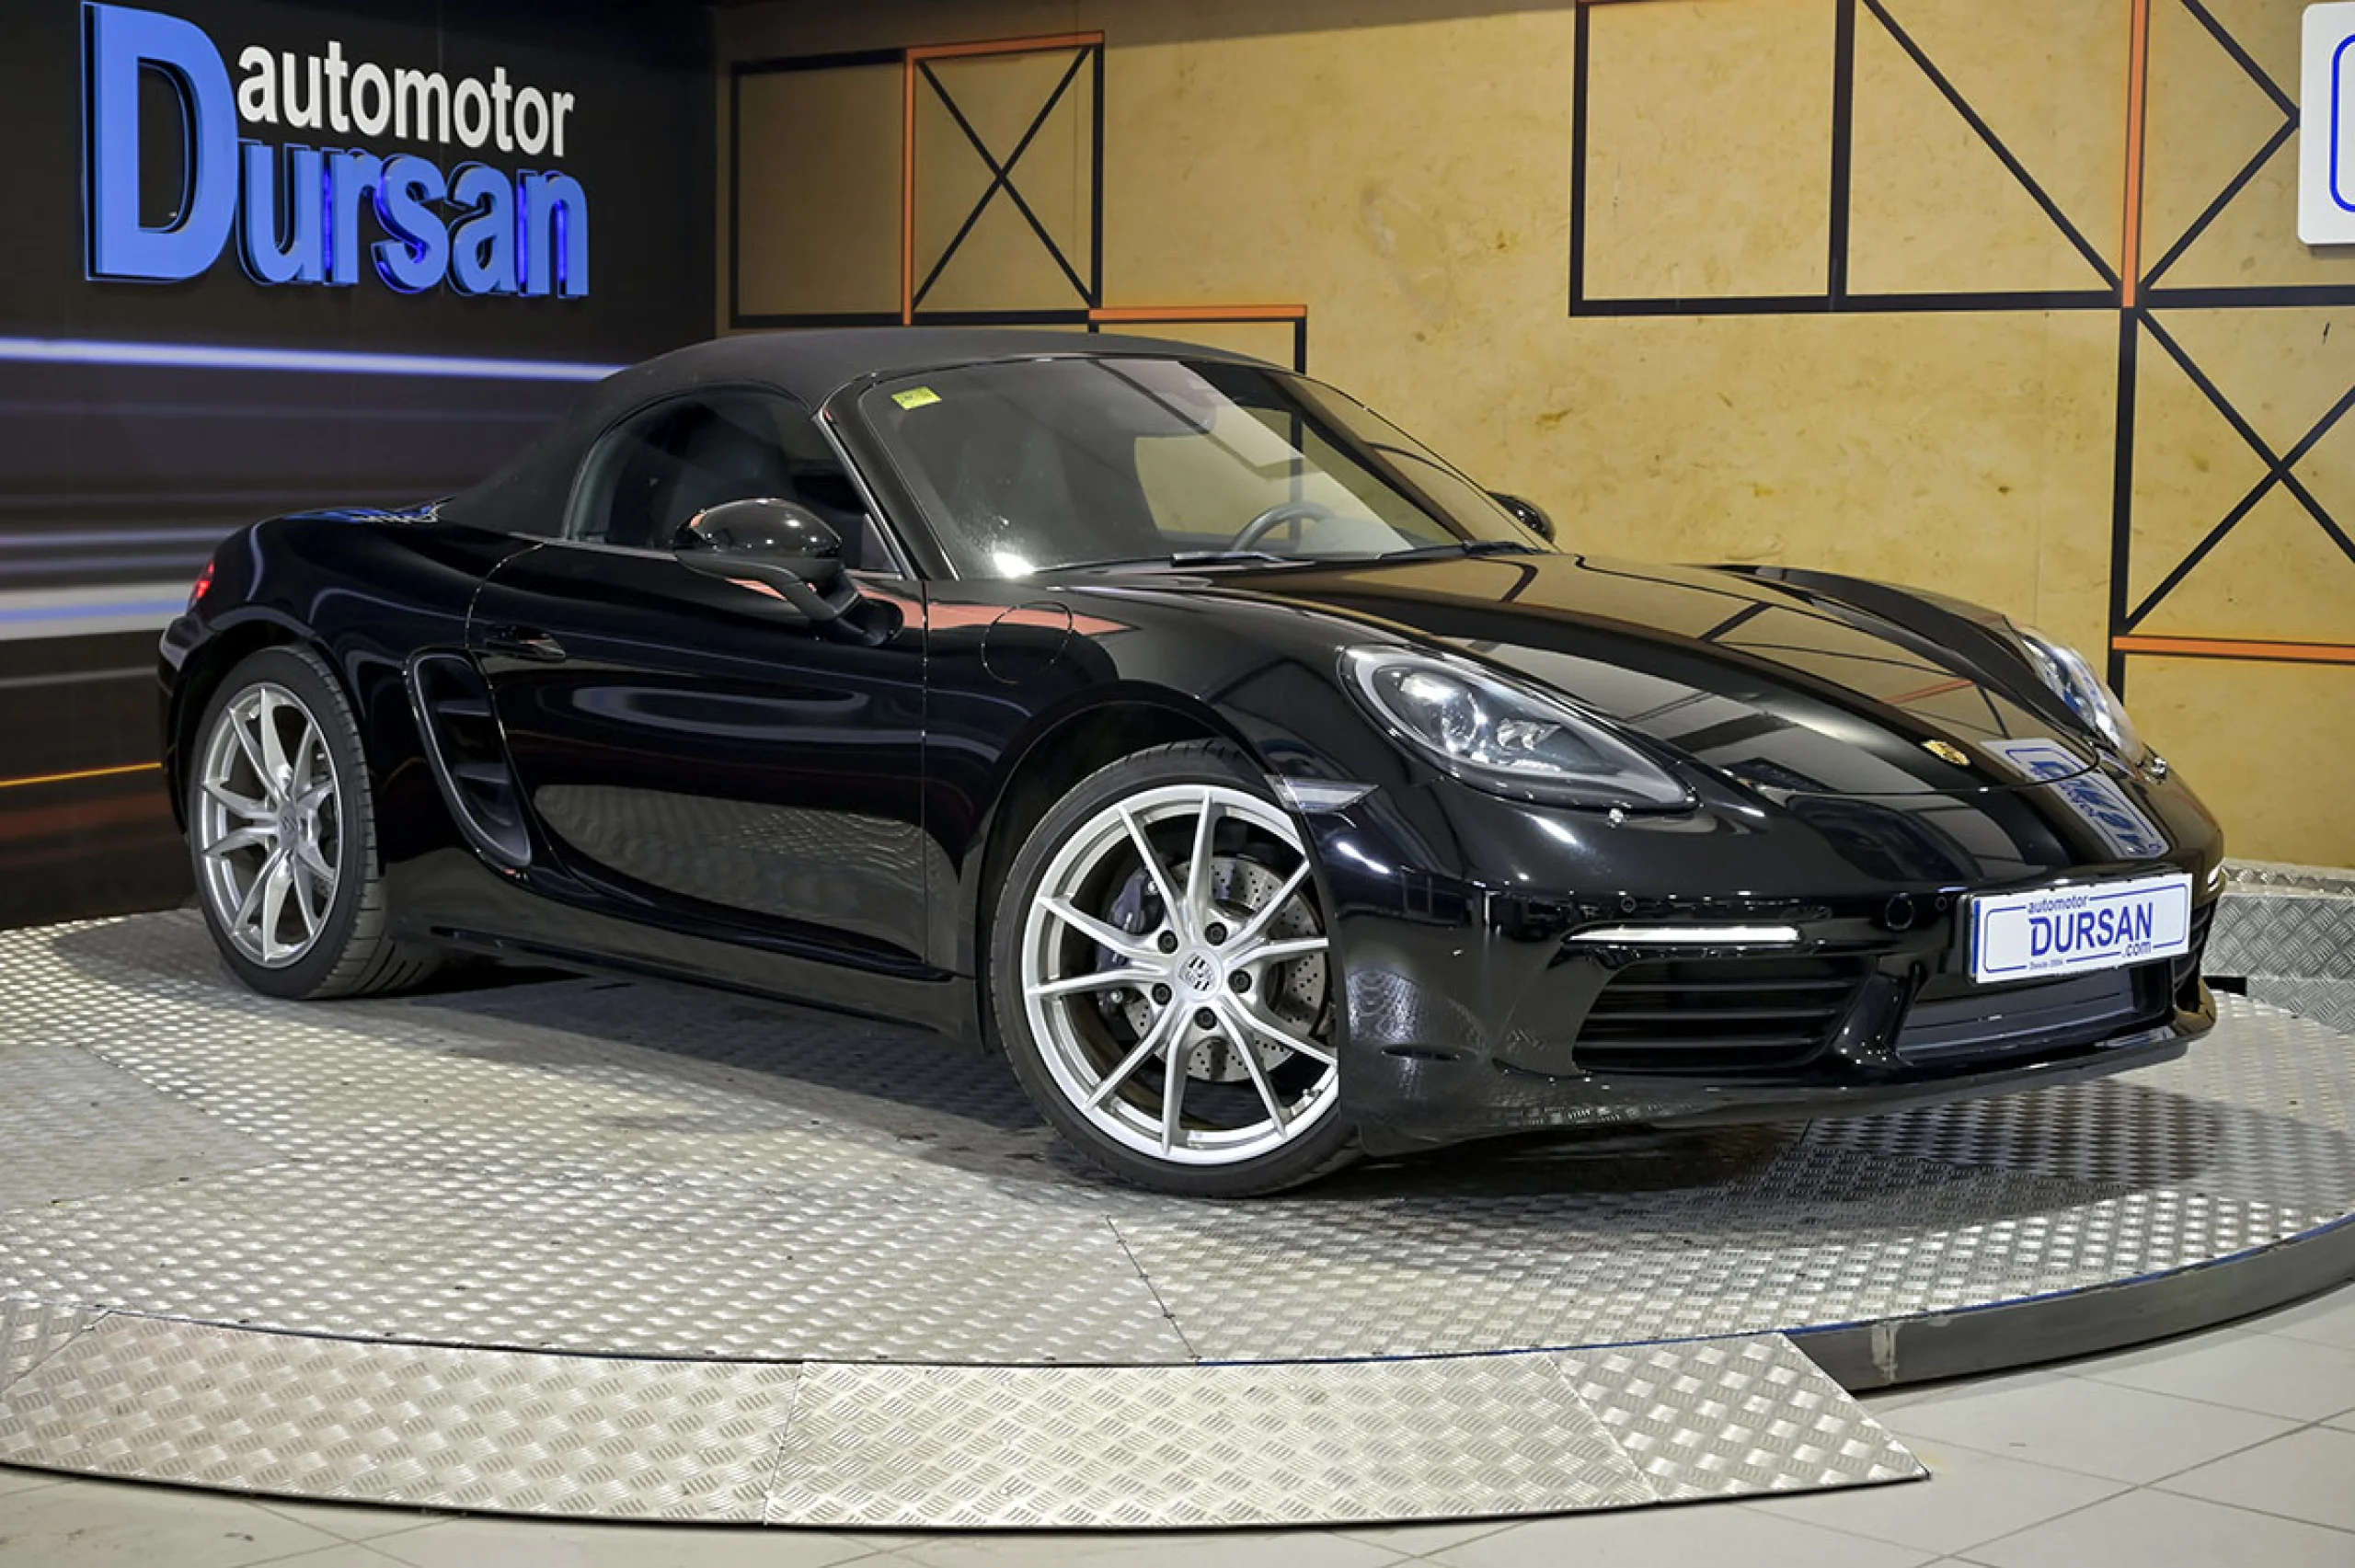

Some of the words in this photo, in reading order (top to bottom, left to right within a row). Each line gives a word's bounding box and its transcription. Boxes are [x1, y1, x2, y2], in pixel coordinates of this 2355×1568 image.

[237, 40, 575, 157] automotor
[82, 1, 591, 297] Dursan
[2028, 895, 2088, 914] automotor
[2028, 901, 2153, 956] DURSAN
[2120, 941, 2151, 957] .com
